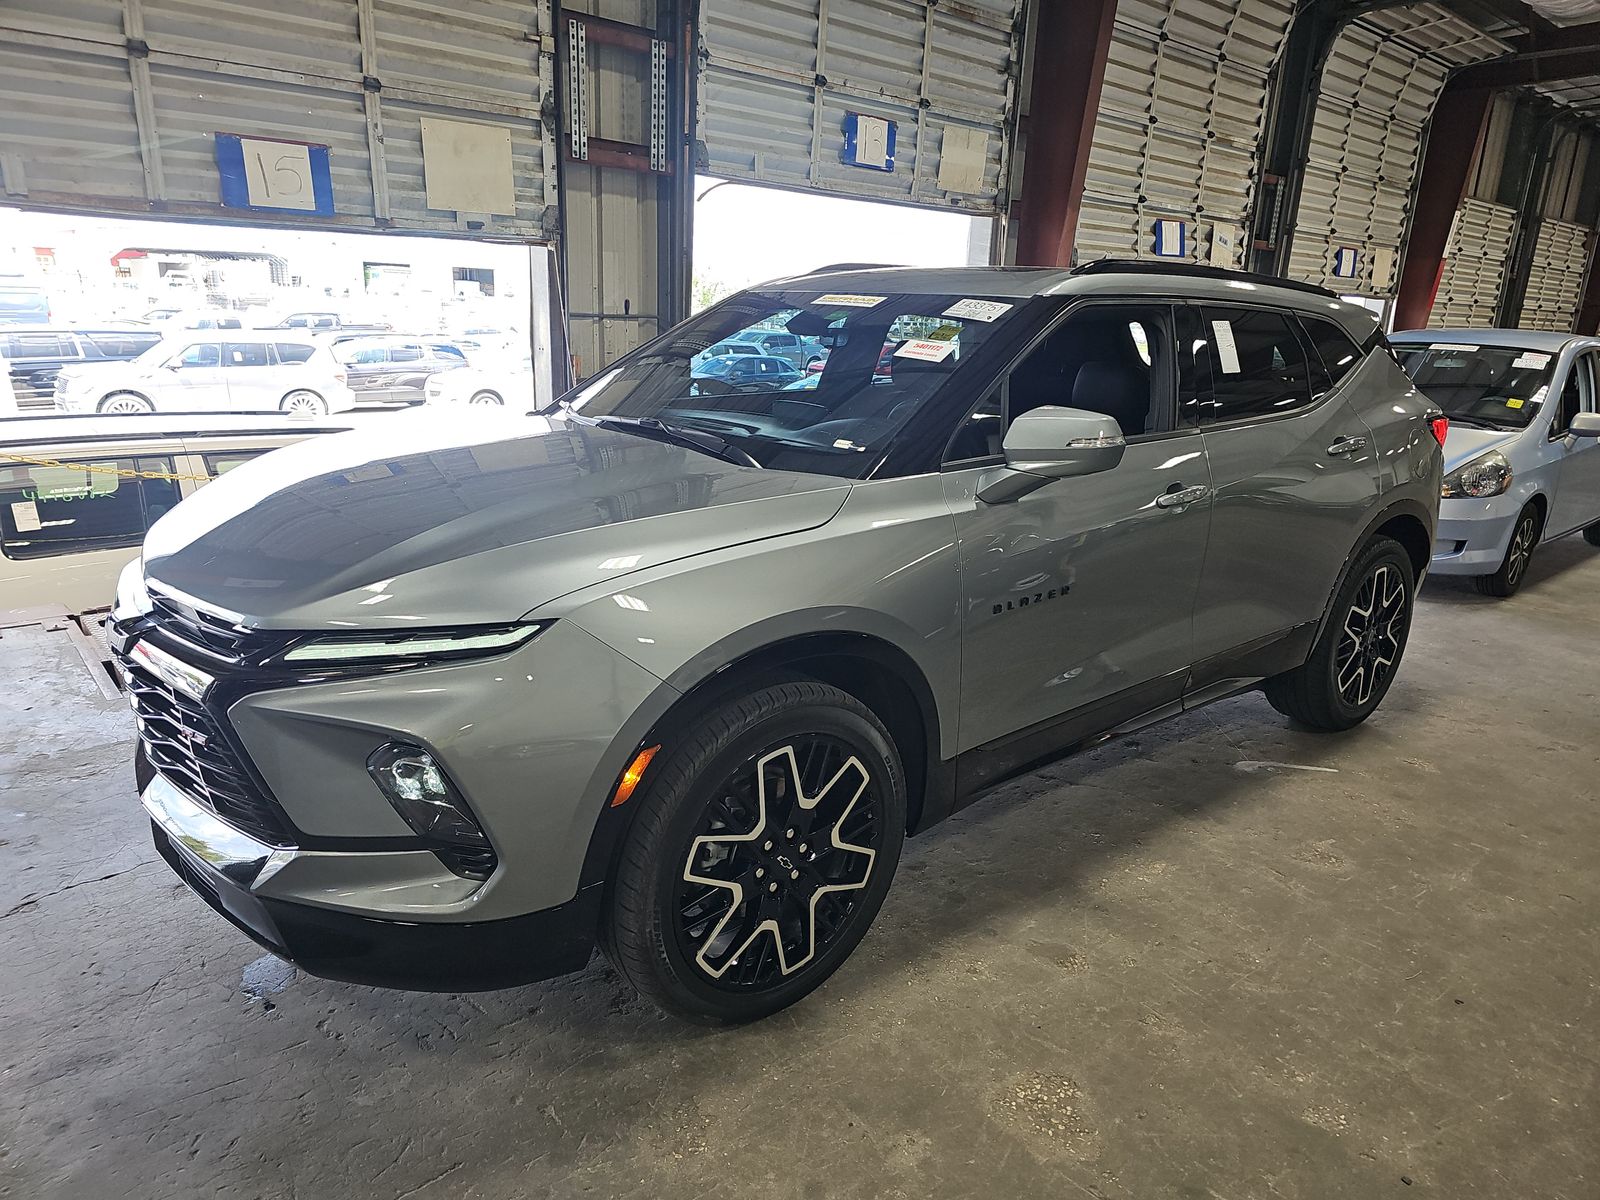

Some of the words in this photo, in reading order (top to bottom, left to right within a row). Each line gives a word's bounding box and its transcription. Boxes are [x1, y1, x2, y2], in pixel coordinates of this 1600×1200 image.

[863, 123, 883, 161] 13
[256, 152, 305, 199] 15
[959, 300, 1005, 313] 1433751
[992, 585, 1070, 614] BLAZER
